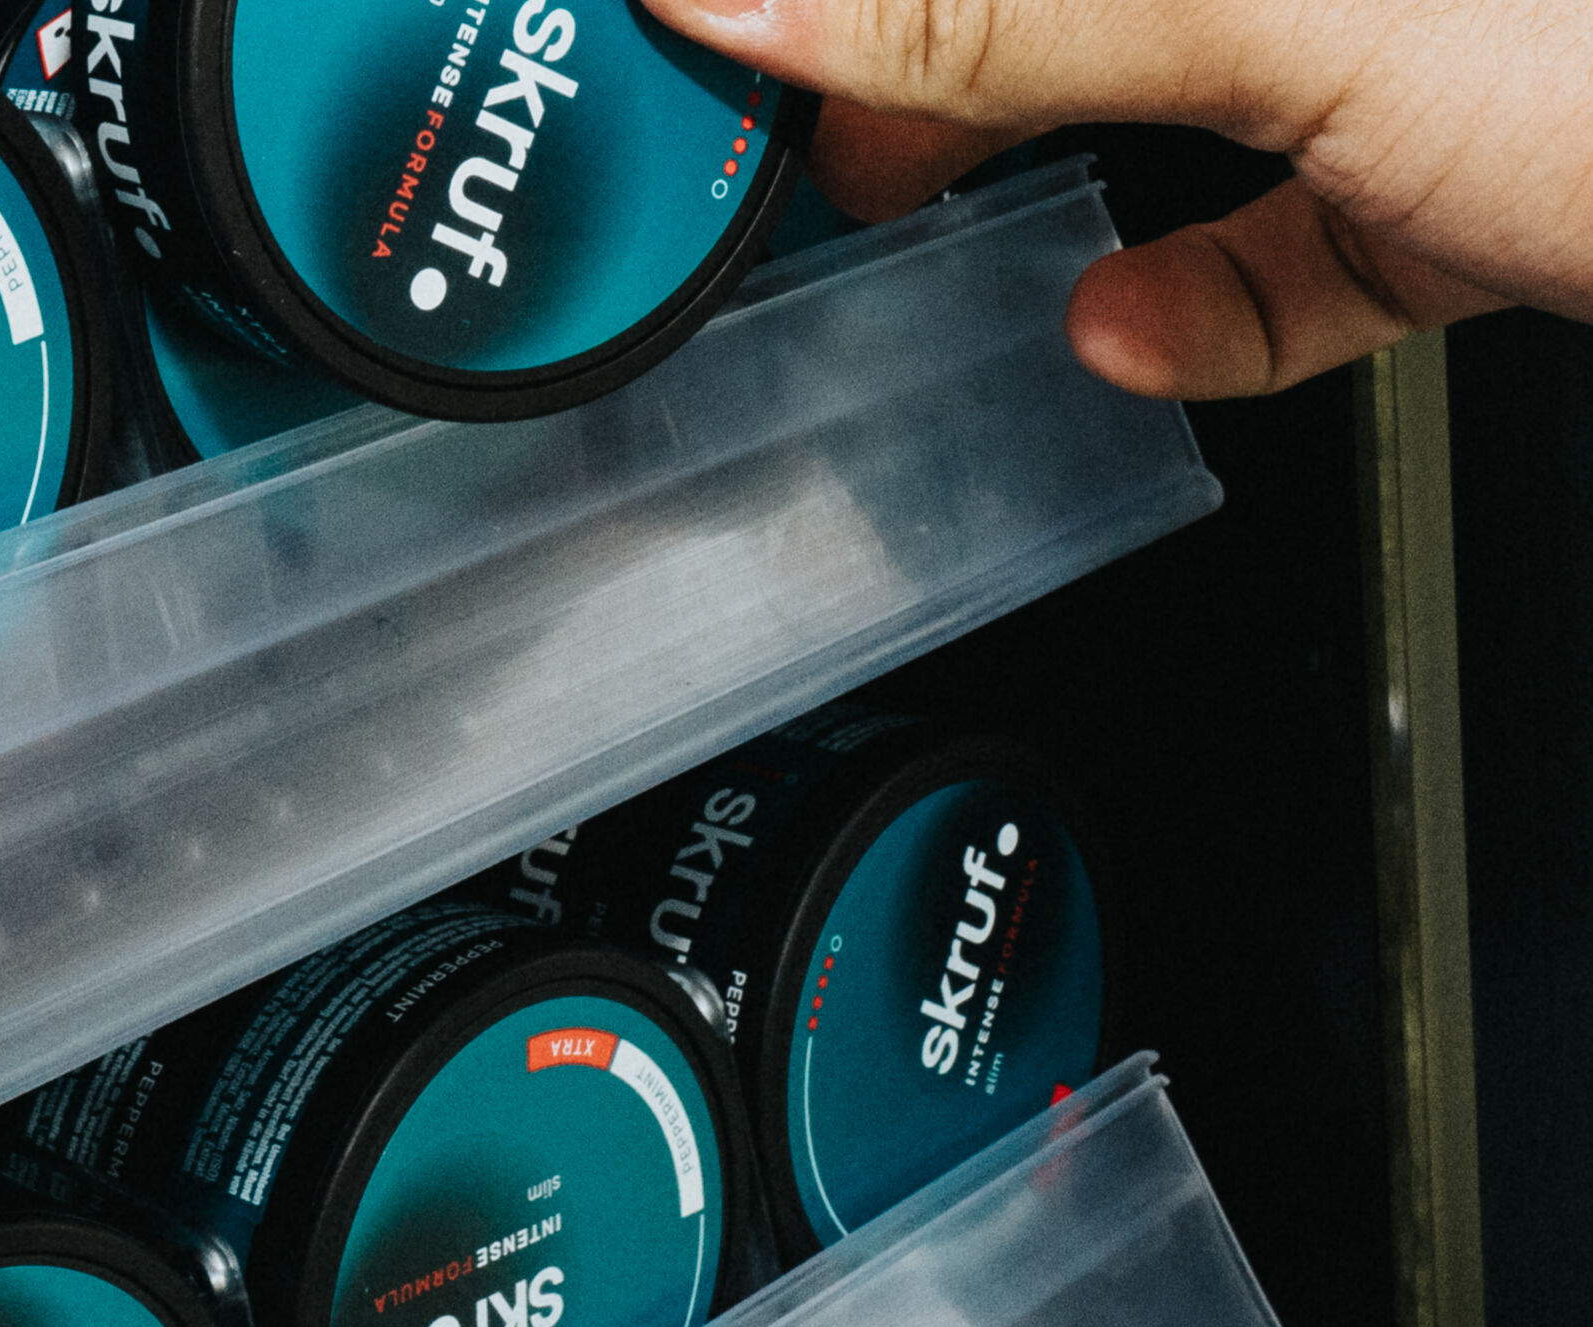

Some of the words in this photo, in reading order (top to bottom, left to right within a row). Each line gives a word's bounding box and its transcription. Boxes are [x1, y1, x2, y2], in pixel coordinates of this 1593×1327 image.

[385, 938, 504, 1024] PEPPERMINT
[551, 1038, 595, 1056] XTRA
[985, 1052, 1005, 1096] slim
[637, 1063, 694, 1175] PEPPERMINT
[527, 1174, 562, 1201] slim
